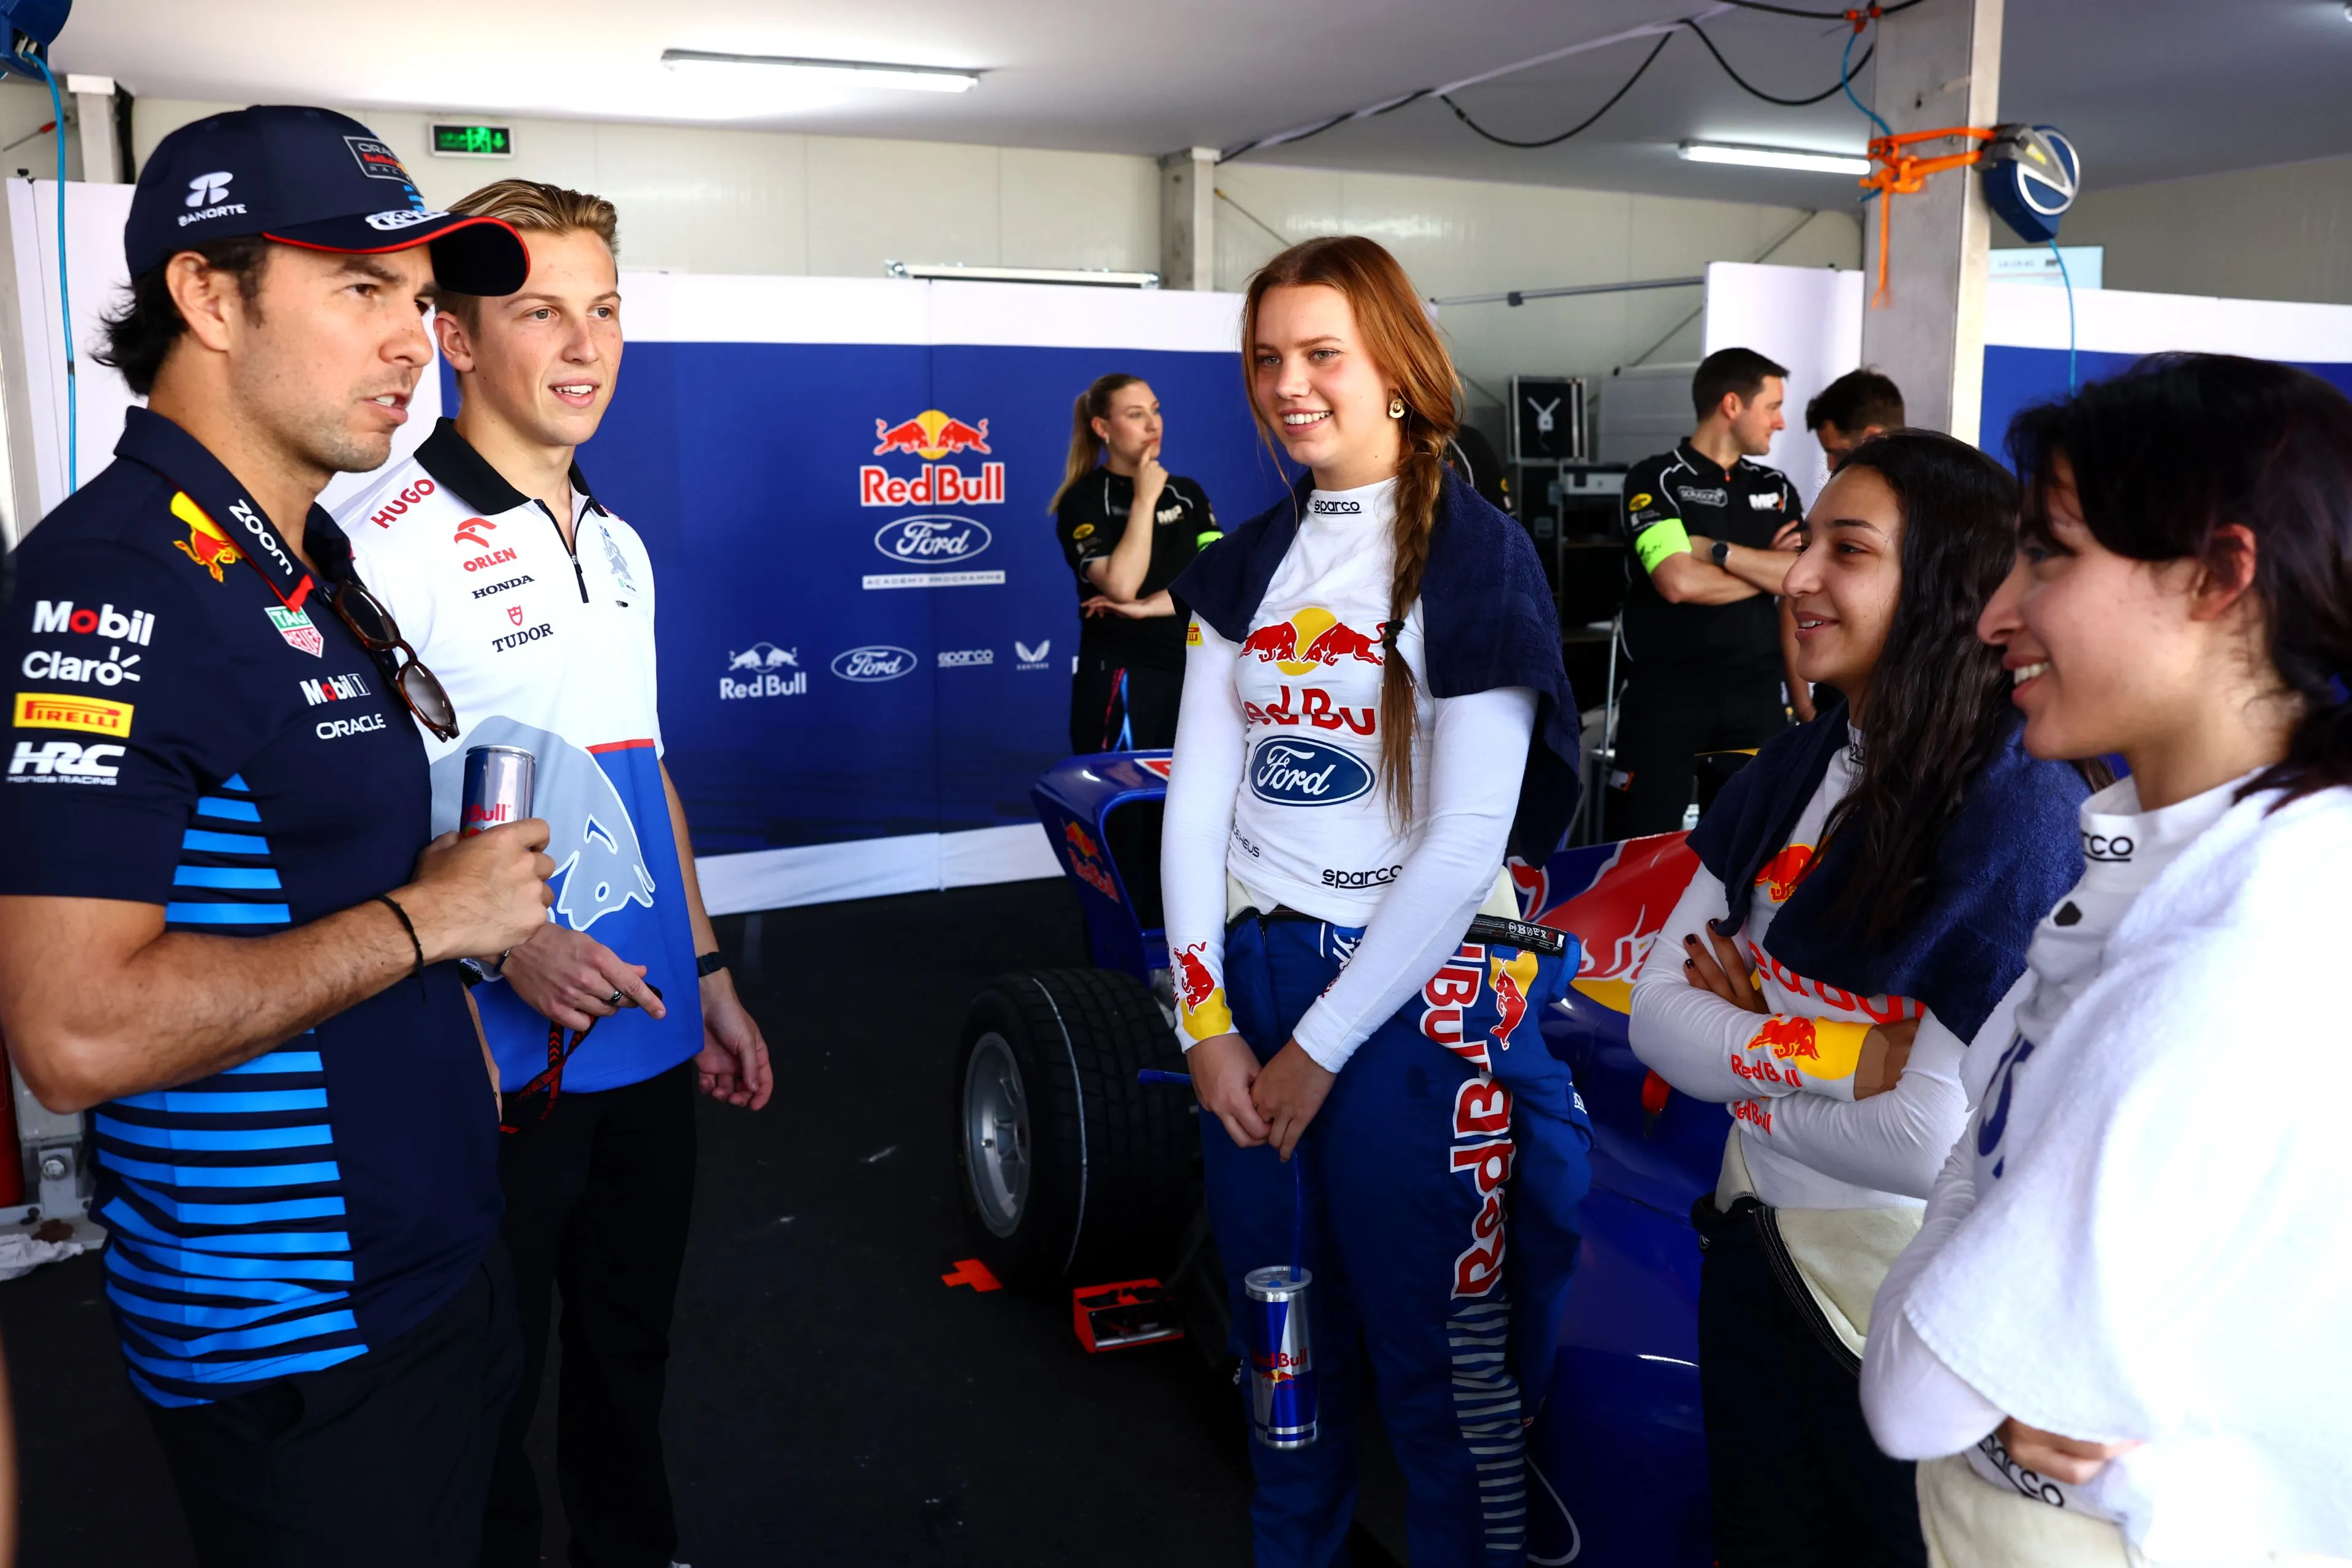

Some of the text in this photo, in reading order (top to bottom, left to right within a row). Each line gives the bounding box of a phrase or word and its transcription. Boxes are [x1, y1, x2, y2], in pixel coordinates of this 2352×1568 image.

[178, 203, 247, 227] BANORTE
[861, 462, 1005, 506] Red Bull
[371, 479, 435, 529] HUGO
[1314, 499, 1361, 514] sparco
[1749, 492, 1779, 510] MP
[229, 499, 293, 575] zoom
[896, 521, 971, 556] Ford
[463, 547, 517, 572] ORLEN
[472, 575, 535, 599] HONDA
[32, 600, 155, 646] Mobil
[271, 609, 311, 627] TAG
[284, 628, 322, 655] HEUER
[492, 623, 553, 652] TUDOR
[22, 650, 123, 686] Claro
[846, 651, 902, 676] Ford
[938, 649, 993, 668] sparco
[300, 674, 368, 706] Mobil 1
[720, 672, 807, 700] Red Bull
[24, 700, 121, 729] PIRELLI
[1243, 682, 1384, 736] ed Bu
[316, 713, 386, 739] ORACLE
[7, 742, 126, 777] HRC
[1257, 745, 1336, 796] Ford
[58, 775, 117, 786] RACING
[470, 804, 506, 823] Bull
[1420, 964, 1492, 1073] Bul
[1730, 1054, 1803, 1088] Red Bll
[1278, 1348, 1306, 1368] Bull
